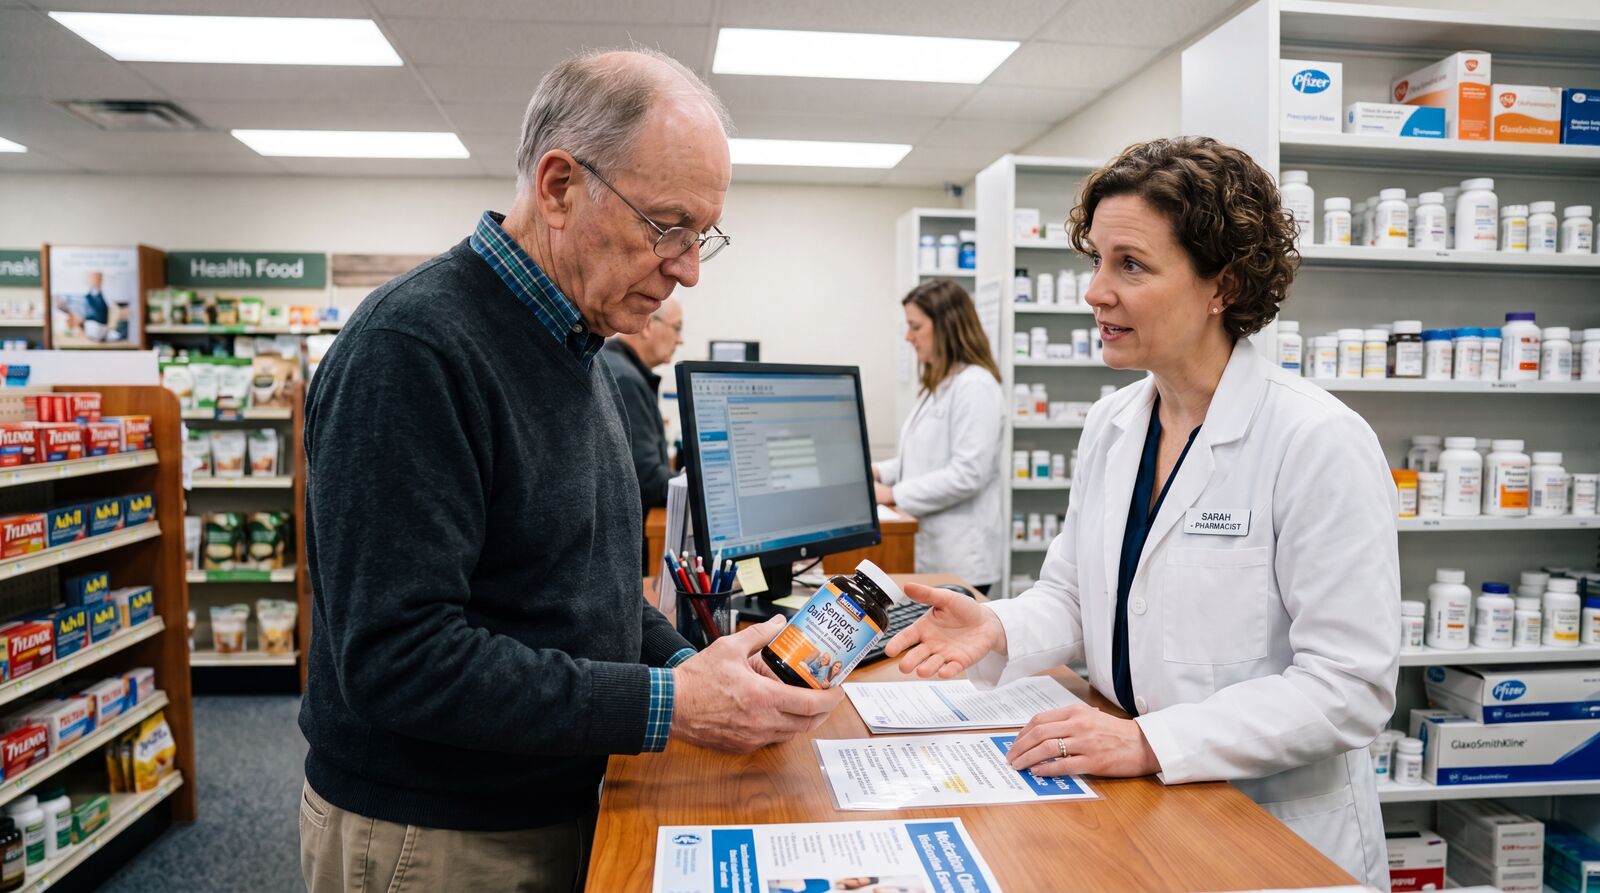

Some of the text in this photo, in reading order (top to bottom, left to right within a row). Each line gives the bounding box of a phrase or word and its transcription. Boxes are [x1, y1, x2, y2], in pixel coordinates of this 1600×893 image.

[1294, 72, 1331, 94] Pfizer
[191, 257, 304, 278] Health Food
[53, 509, 82, 530] Advil
[1194, 522, 1242, 530] PHARMACIST
[1201, 512, 1231, 521] SARAH
[4, 520, 43, 543] TYLENOL
[59, 611, 86, 635] Advil
[808, 605, 828, 625] Daily
[827, 618, 857, 653] Vitality
[11, 629, 51, 657] TYLENOL
[1493, 681, 1525, 701] Pfizer
[7, 729, 47, 762] TYLENOL
[934, 830, 965, 873] Medication
